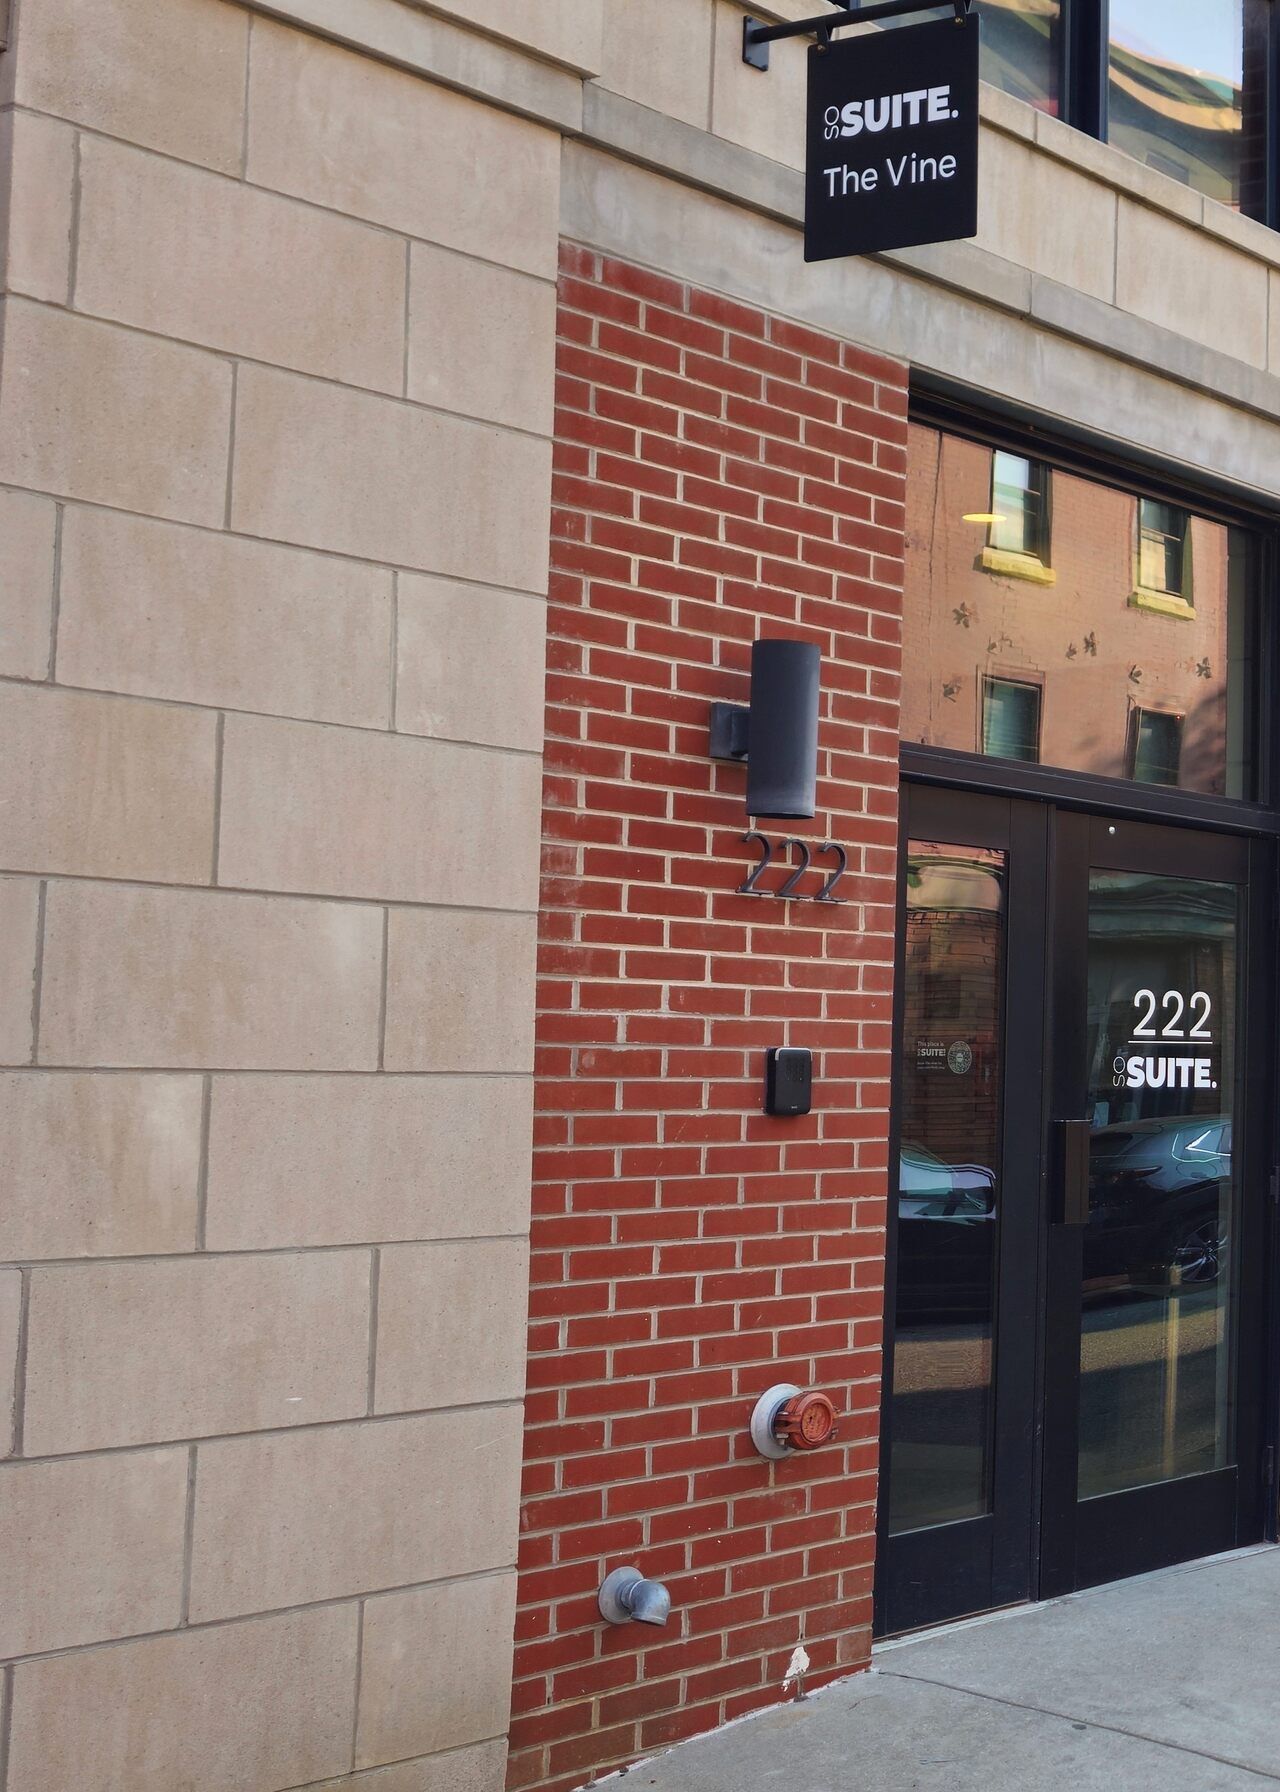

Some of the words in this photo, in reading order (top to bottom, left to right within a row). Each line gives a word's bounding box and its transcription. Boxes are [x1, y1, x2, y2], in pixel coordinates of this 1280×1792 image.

[824, 105, 840, 140] SO
[840, 84, 959, 137] SUITE.
[823, 164, 878, 197] The
[886, 153, 957, 186] Vine
[735, 832, 848, 903] 222
[1133, 989, 1212, 1038] 222
[1113, 1056, 1126, 1087] SO
[1126, 1056, 1218, 1089] SUITE.
